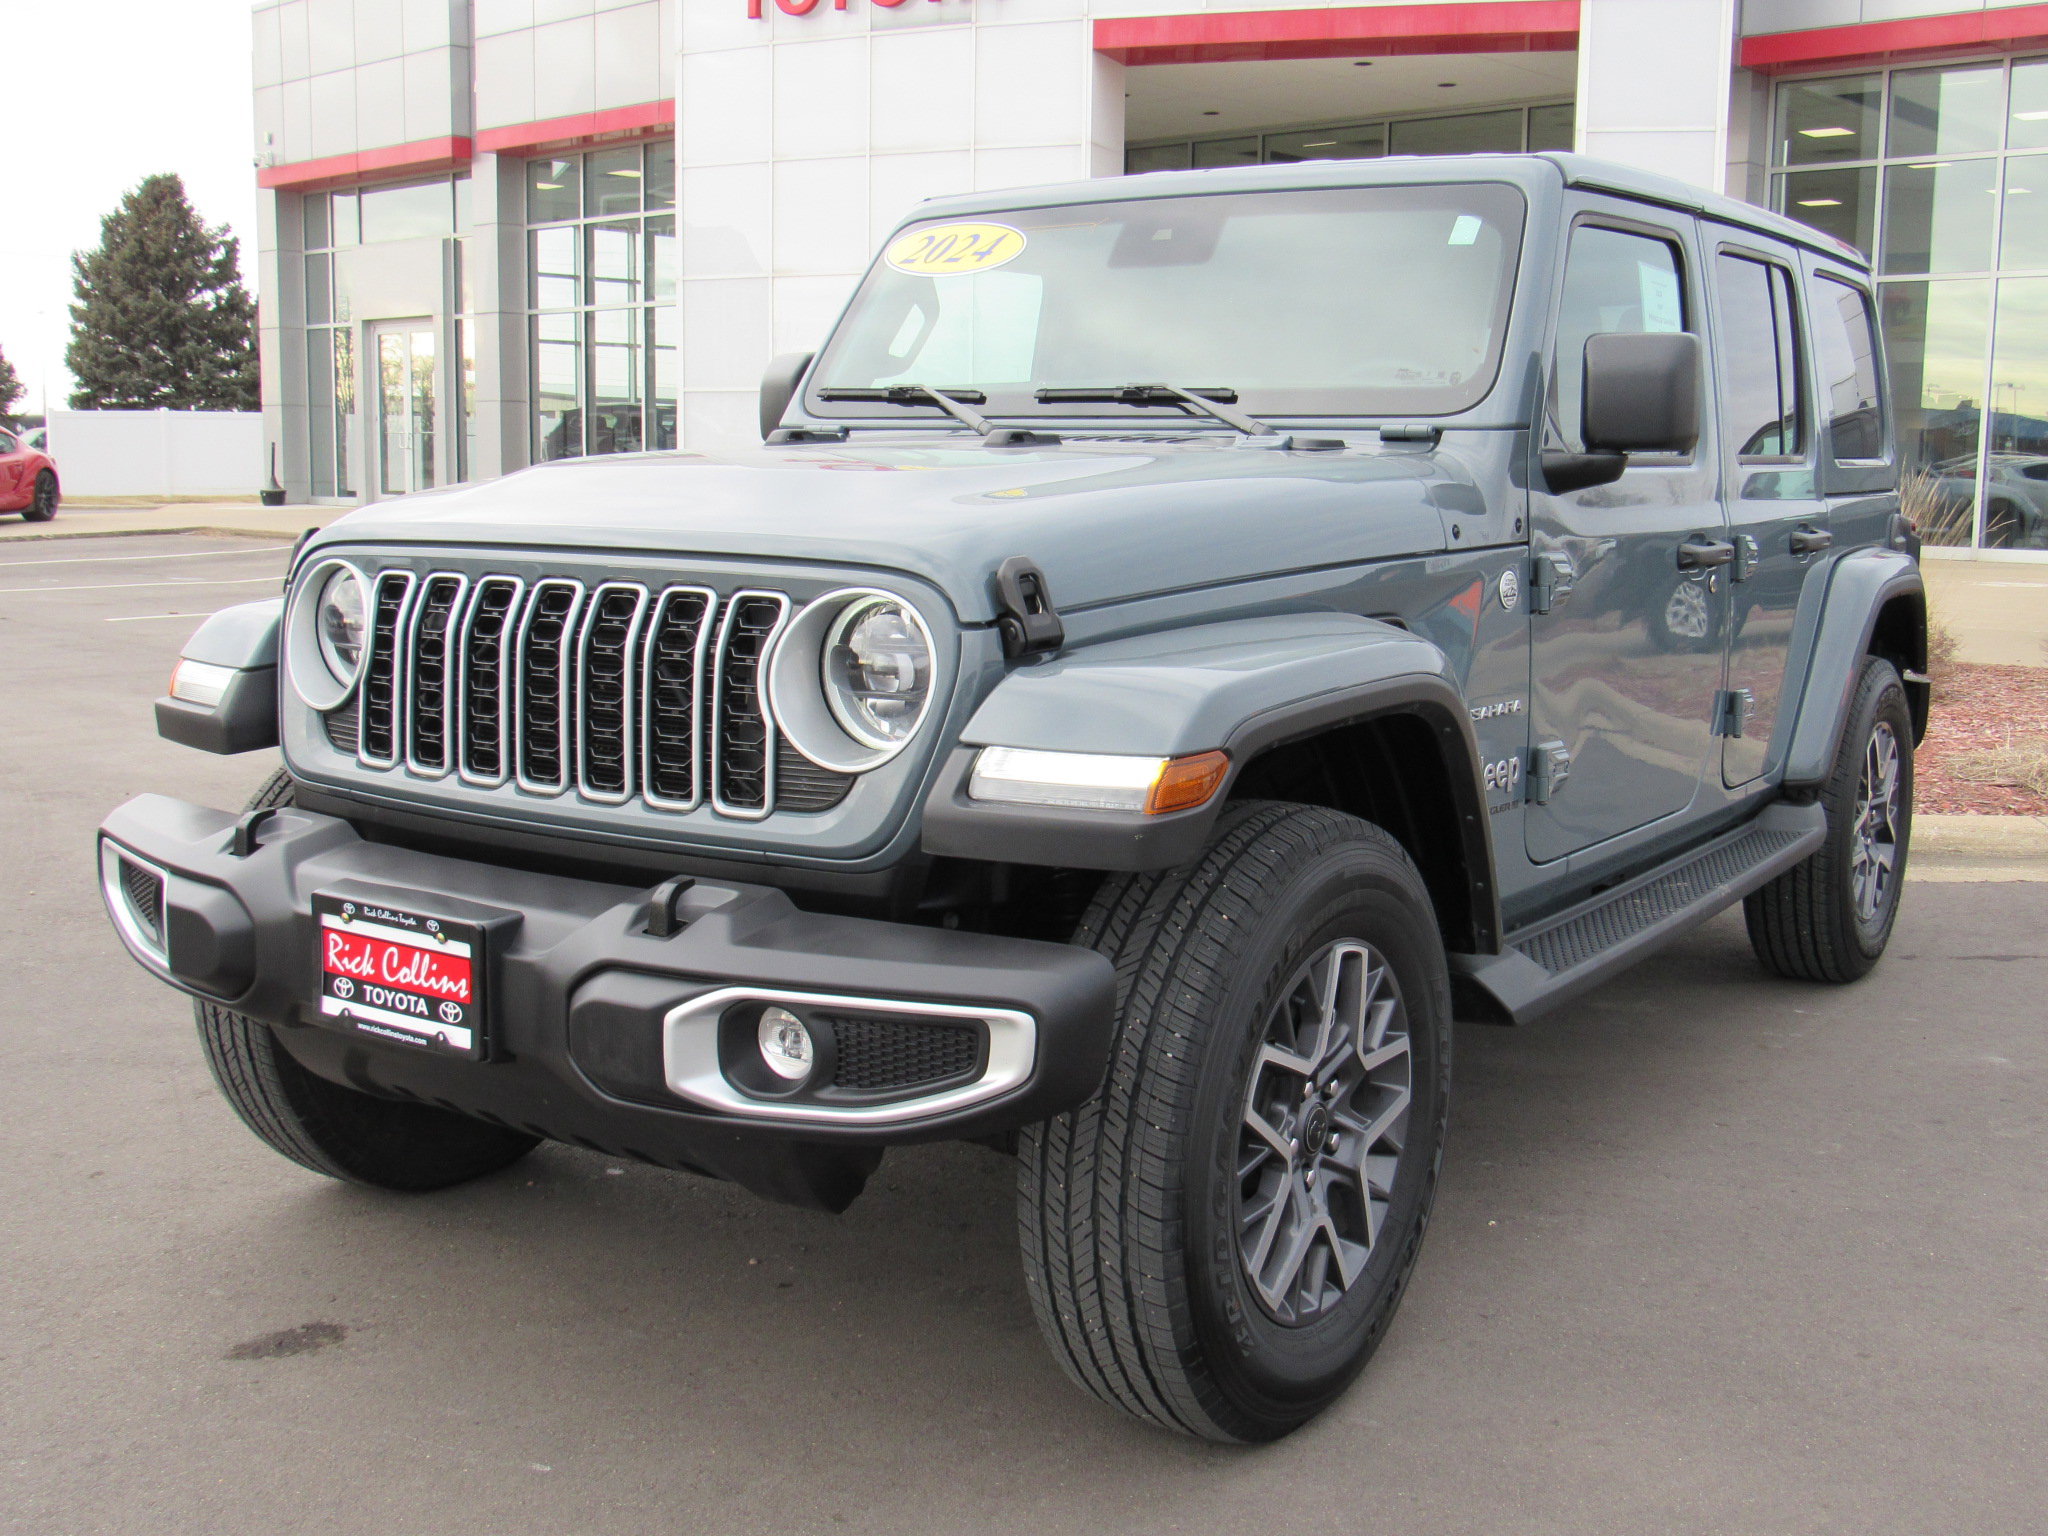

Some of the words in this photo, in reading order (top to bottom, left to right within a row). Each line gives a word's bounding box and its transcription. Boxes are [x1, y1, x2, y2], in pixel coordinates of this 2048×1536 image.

[898, 233, 1009, 264] 2024
[1470, 699, 1521, 721] SAHARA
[1480, 755, 1520, 793] eep
[398, 913, 417, 926] Toyota
[328, 932, 375, 976] Rick
[382, 946, 469, 998] Collins
[363, 984, 429, 1016] TOYOTA
